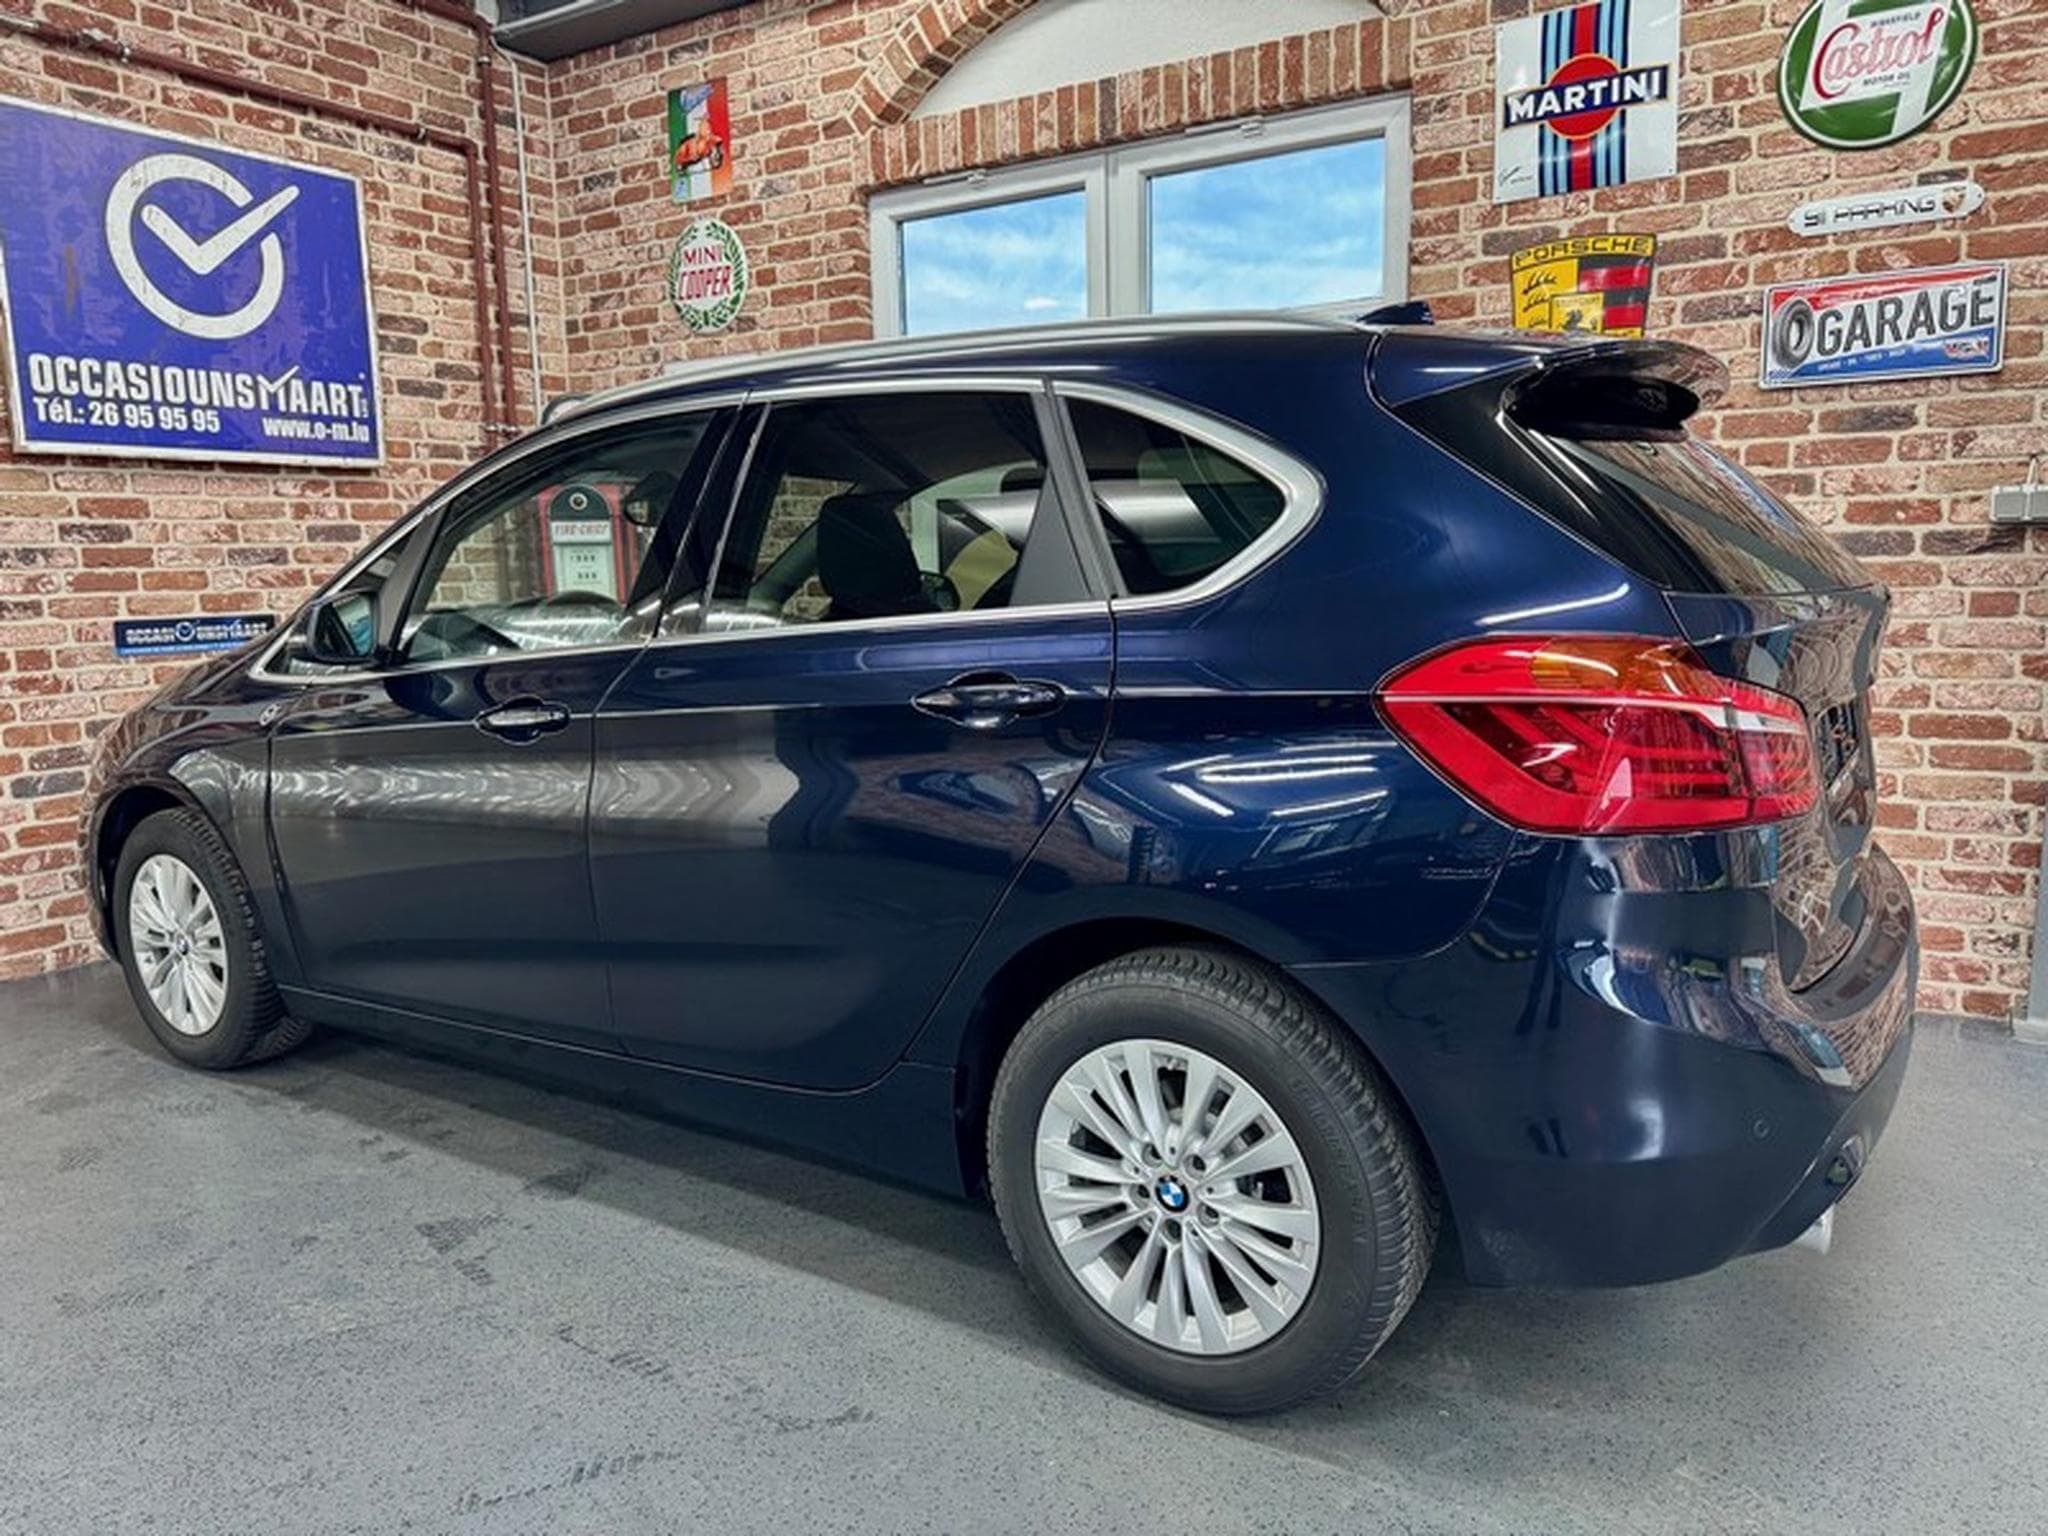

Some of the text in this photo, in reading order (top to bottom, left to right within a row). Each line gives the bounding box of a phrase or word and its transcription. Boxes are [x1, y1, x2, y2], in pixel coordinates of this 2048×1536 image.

[1812, 7, 1945, 99] Castrol
[1507, 69, 1662, 123] MARTINI
[1832, 195, 1935, 223] PARKING
[683, 244, 722, 265] MINI
[1515, 237, 1649, 267] PORSCHE
[679, 265, 731, 300] COOPER
[1816, 276, 1998, 357] GARAGE
[88, 401, 119, 427] 26
[124, 403, 154, 429] 95
[158, 406, 188, 431] 95
[191, 409, 220, 433] 95
